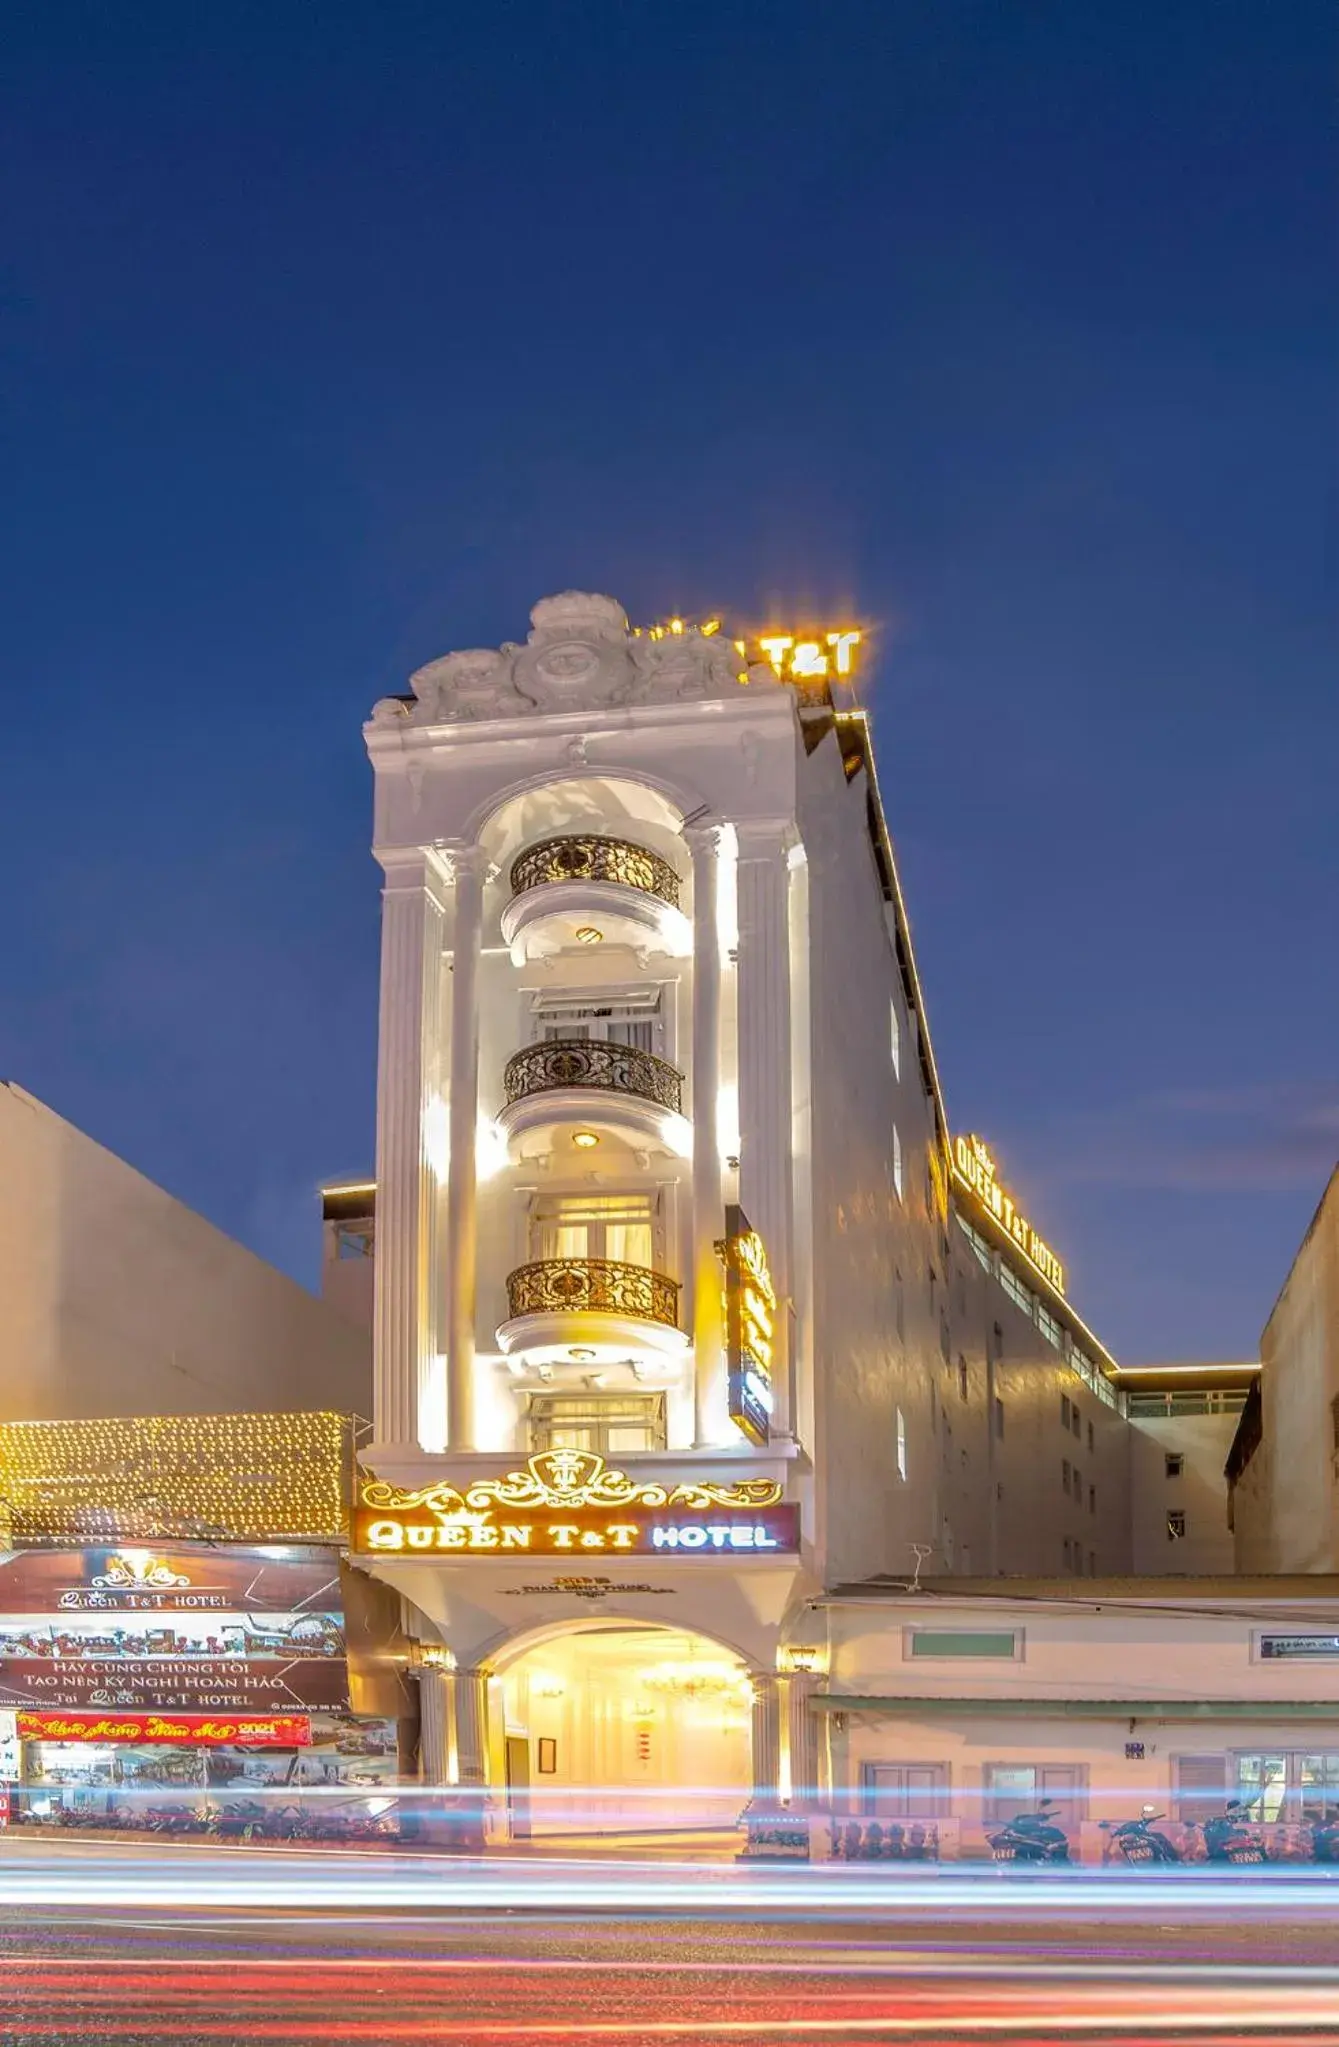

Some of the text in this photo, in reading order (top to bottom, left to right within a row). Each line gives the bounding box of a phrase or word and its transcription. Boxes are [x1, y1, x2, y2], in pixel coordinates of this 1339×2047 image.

[759, 631, 861, 677] T&T
[956, 1135, 1066, 1295] QUEEN T&T HOTEL
[367, 1520, 778, 1550] QUEEN T&T HOTEL
[57, 1592, 233, 1609] Queen T&T HOTEL
[91, 1661, 142, 1674] CÙNG
[146, 1661, 214, 1674] CHÚNG
[87, 1689, 145, 1707] Queen
[152, 1693, 192, 1705] T&T
[197, 1694, 254, 1706] HOTEL
[237, 1723, 276, 1735] 2021
